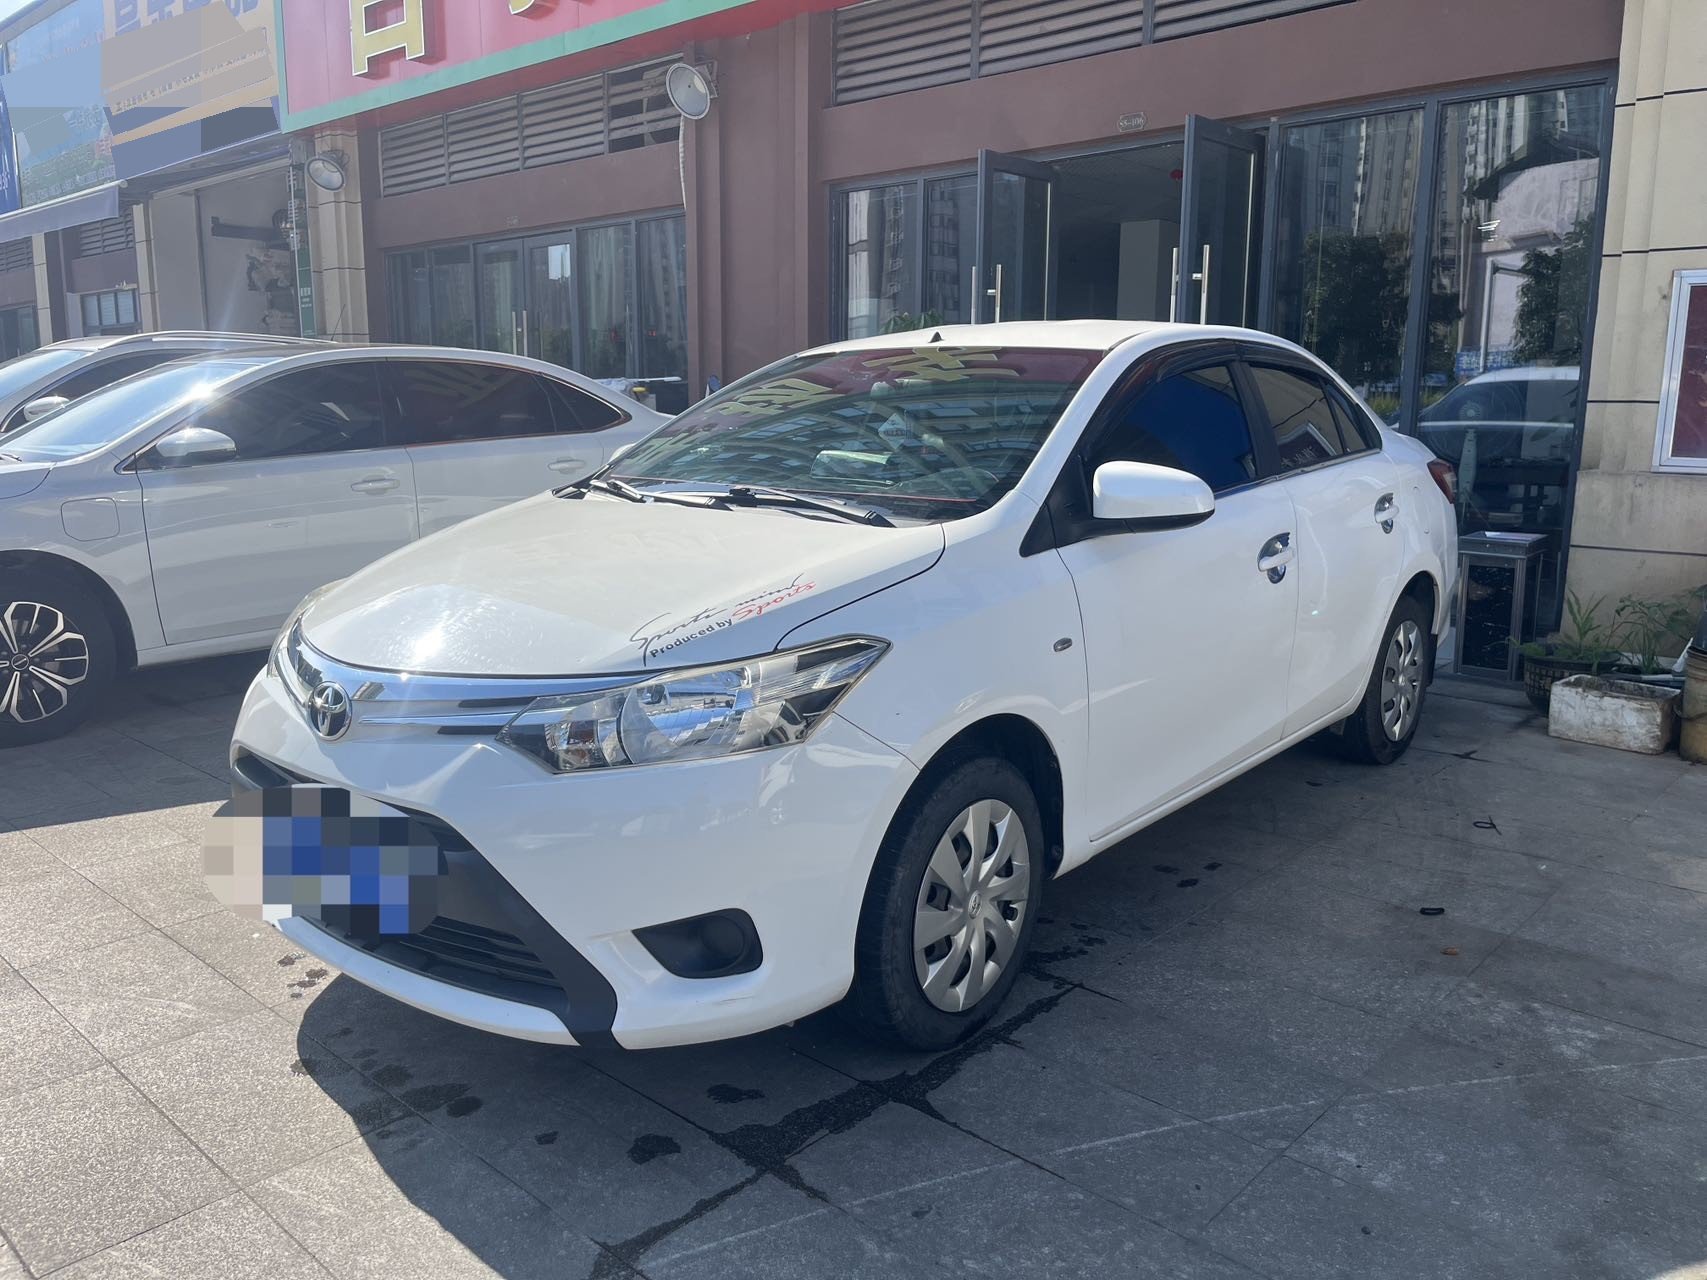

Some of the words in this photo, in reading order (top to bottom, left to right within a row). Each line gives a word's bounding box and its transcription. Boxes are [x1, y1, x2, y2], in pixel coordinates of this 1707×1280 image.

[649, 624, 715, 658] Produced
[715, 618, 733, 627] by
[732, 581, 816, 620] Sports
